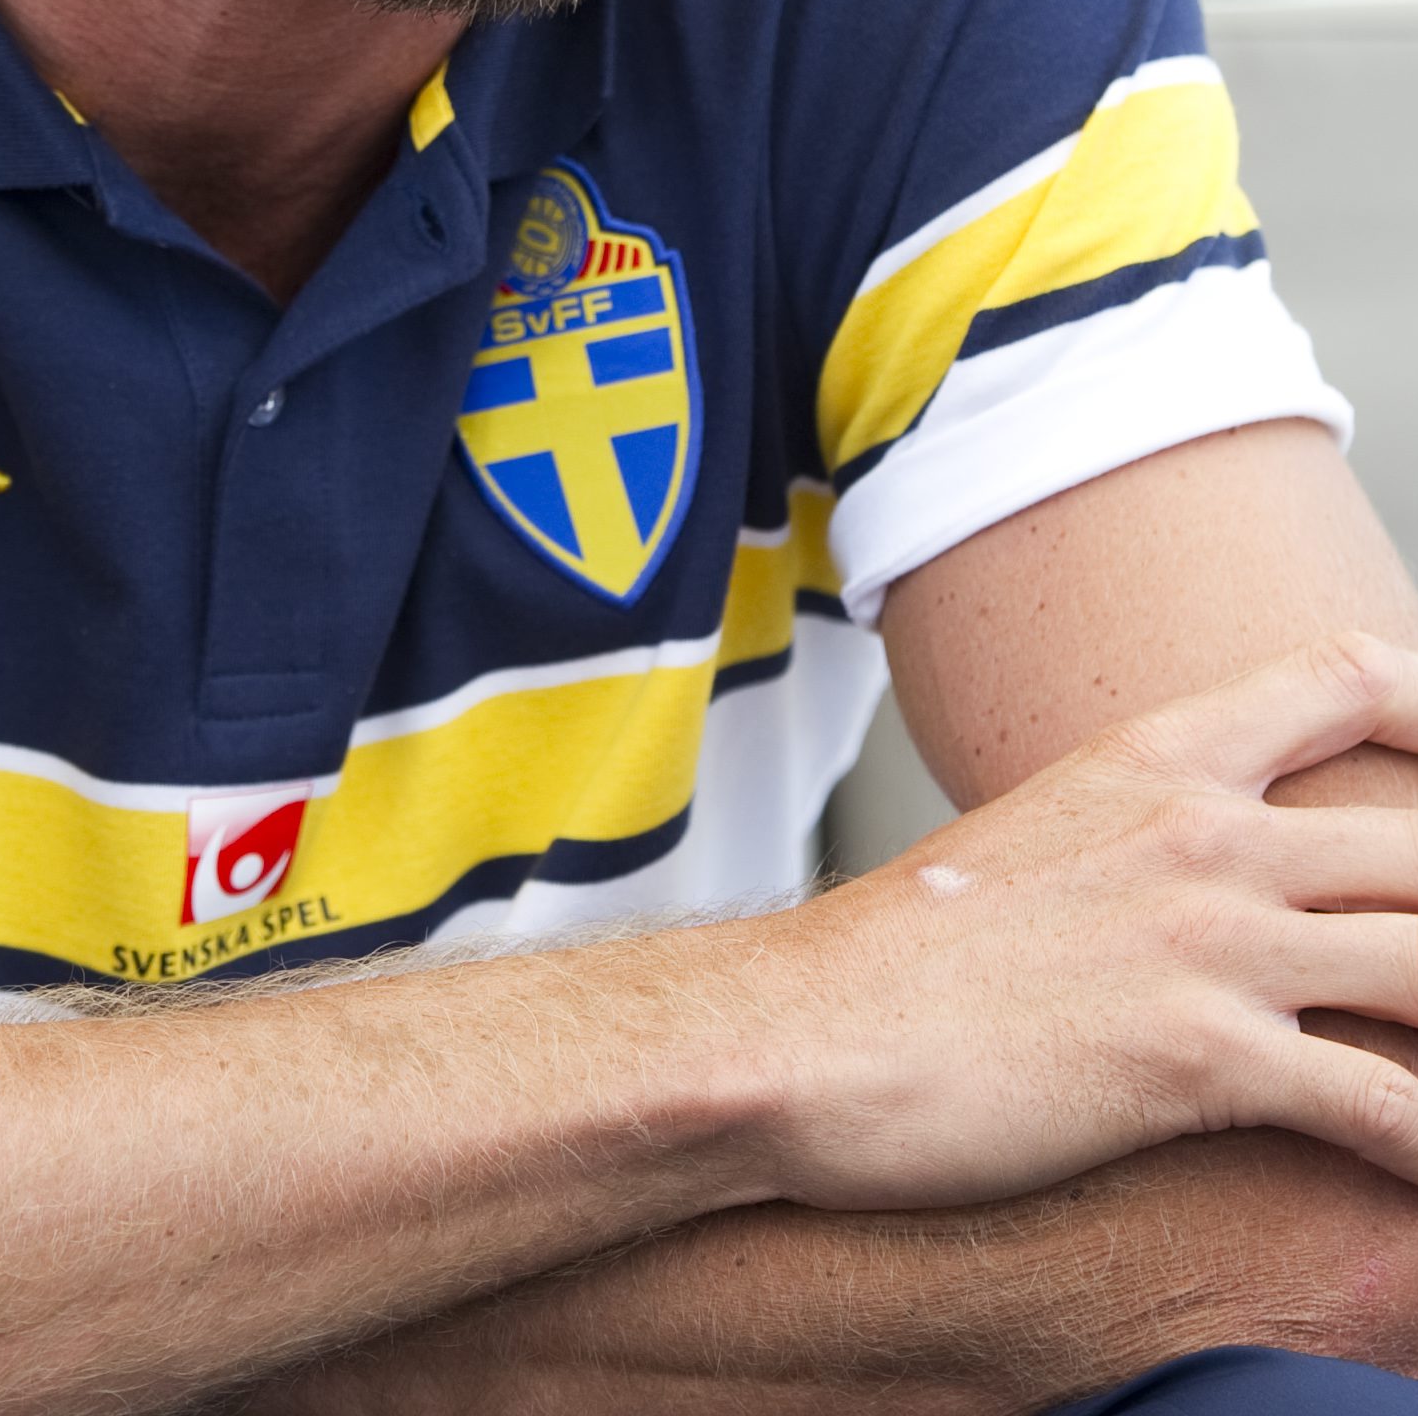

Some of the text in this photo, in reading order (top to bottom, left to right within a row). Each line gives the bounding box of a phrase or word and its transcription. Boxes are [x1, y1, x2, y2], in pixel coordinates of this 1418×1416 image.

[491, 289, 613, 343] SvFF
[112, 897, 341, 977] SVENSKA SPEL
